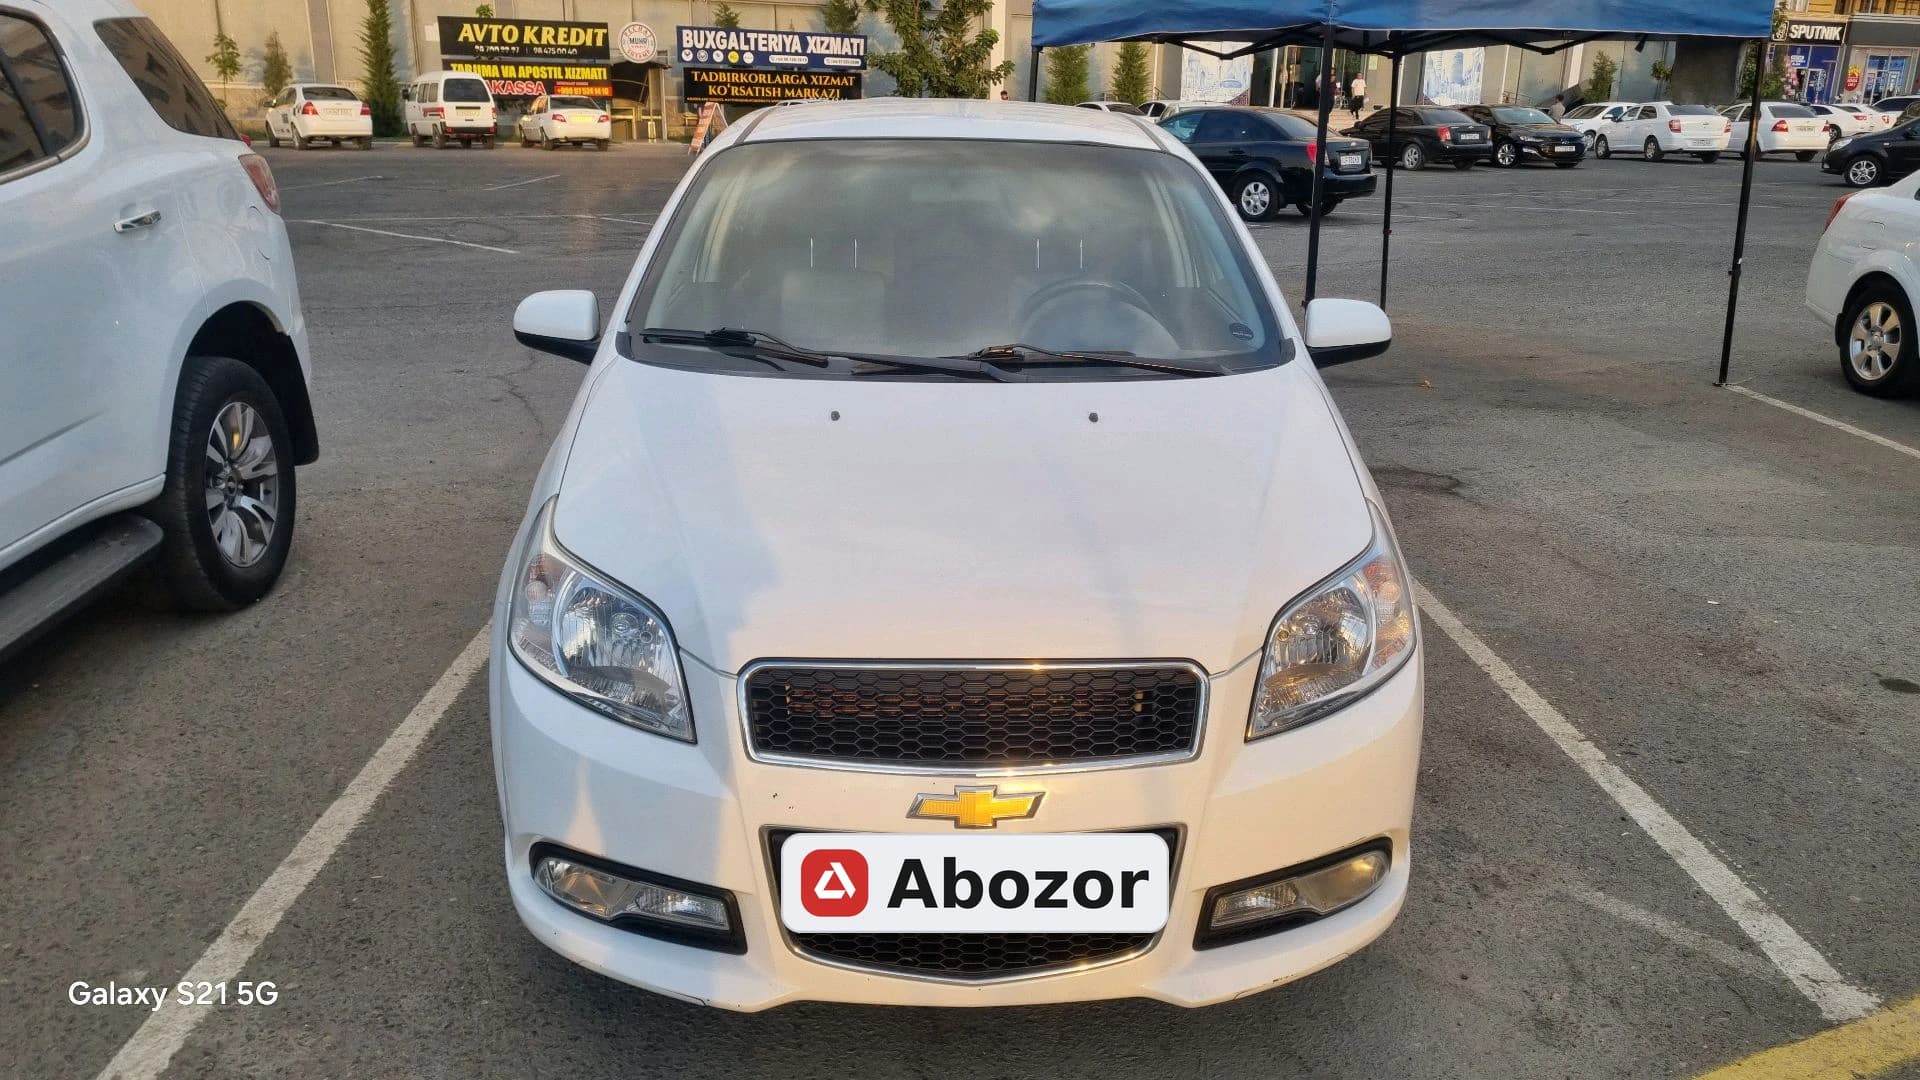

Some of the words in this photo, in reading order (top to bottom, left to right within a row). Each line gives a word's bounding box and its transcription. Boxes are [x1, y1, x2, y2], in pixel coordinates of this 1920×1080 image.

[458, 23, 519, 44] AVTO
[523, 25, 608, 47] KREDIT
[1789, 24, 1843, 40] SPUTNIK
[681, 29, 802, 53] BUXGALTERIYA
[806, 35, 866, 56] XIZMATI
[501, 65, 516, 79] VA
[518, 65, 563, 79] APOSTIL
[565, 67, 608, 80] XIZMATI
[691, 70, 808, 85] TADBIRKORLARGA
[810, 74, 856, 86] XIZMAT
[784, 87, 841, 98] MARKAZI
